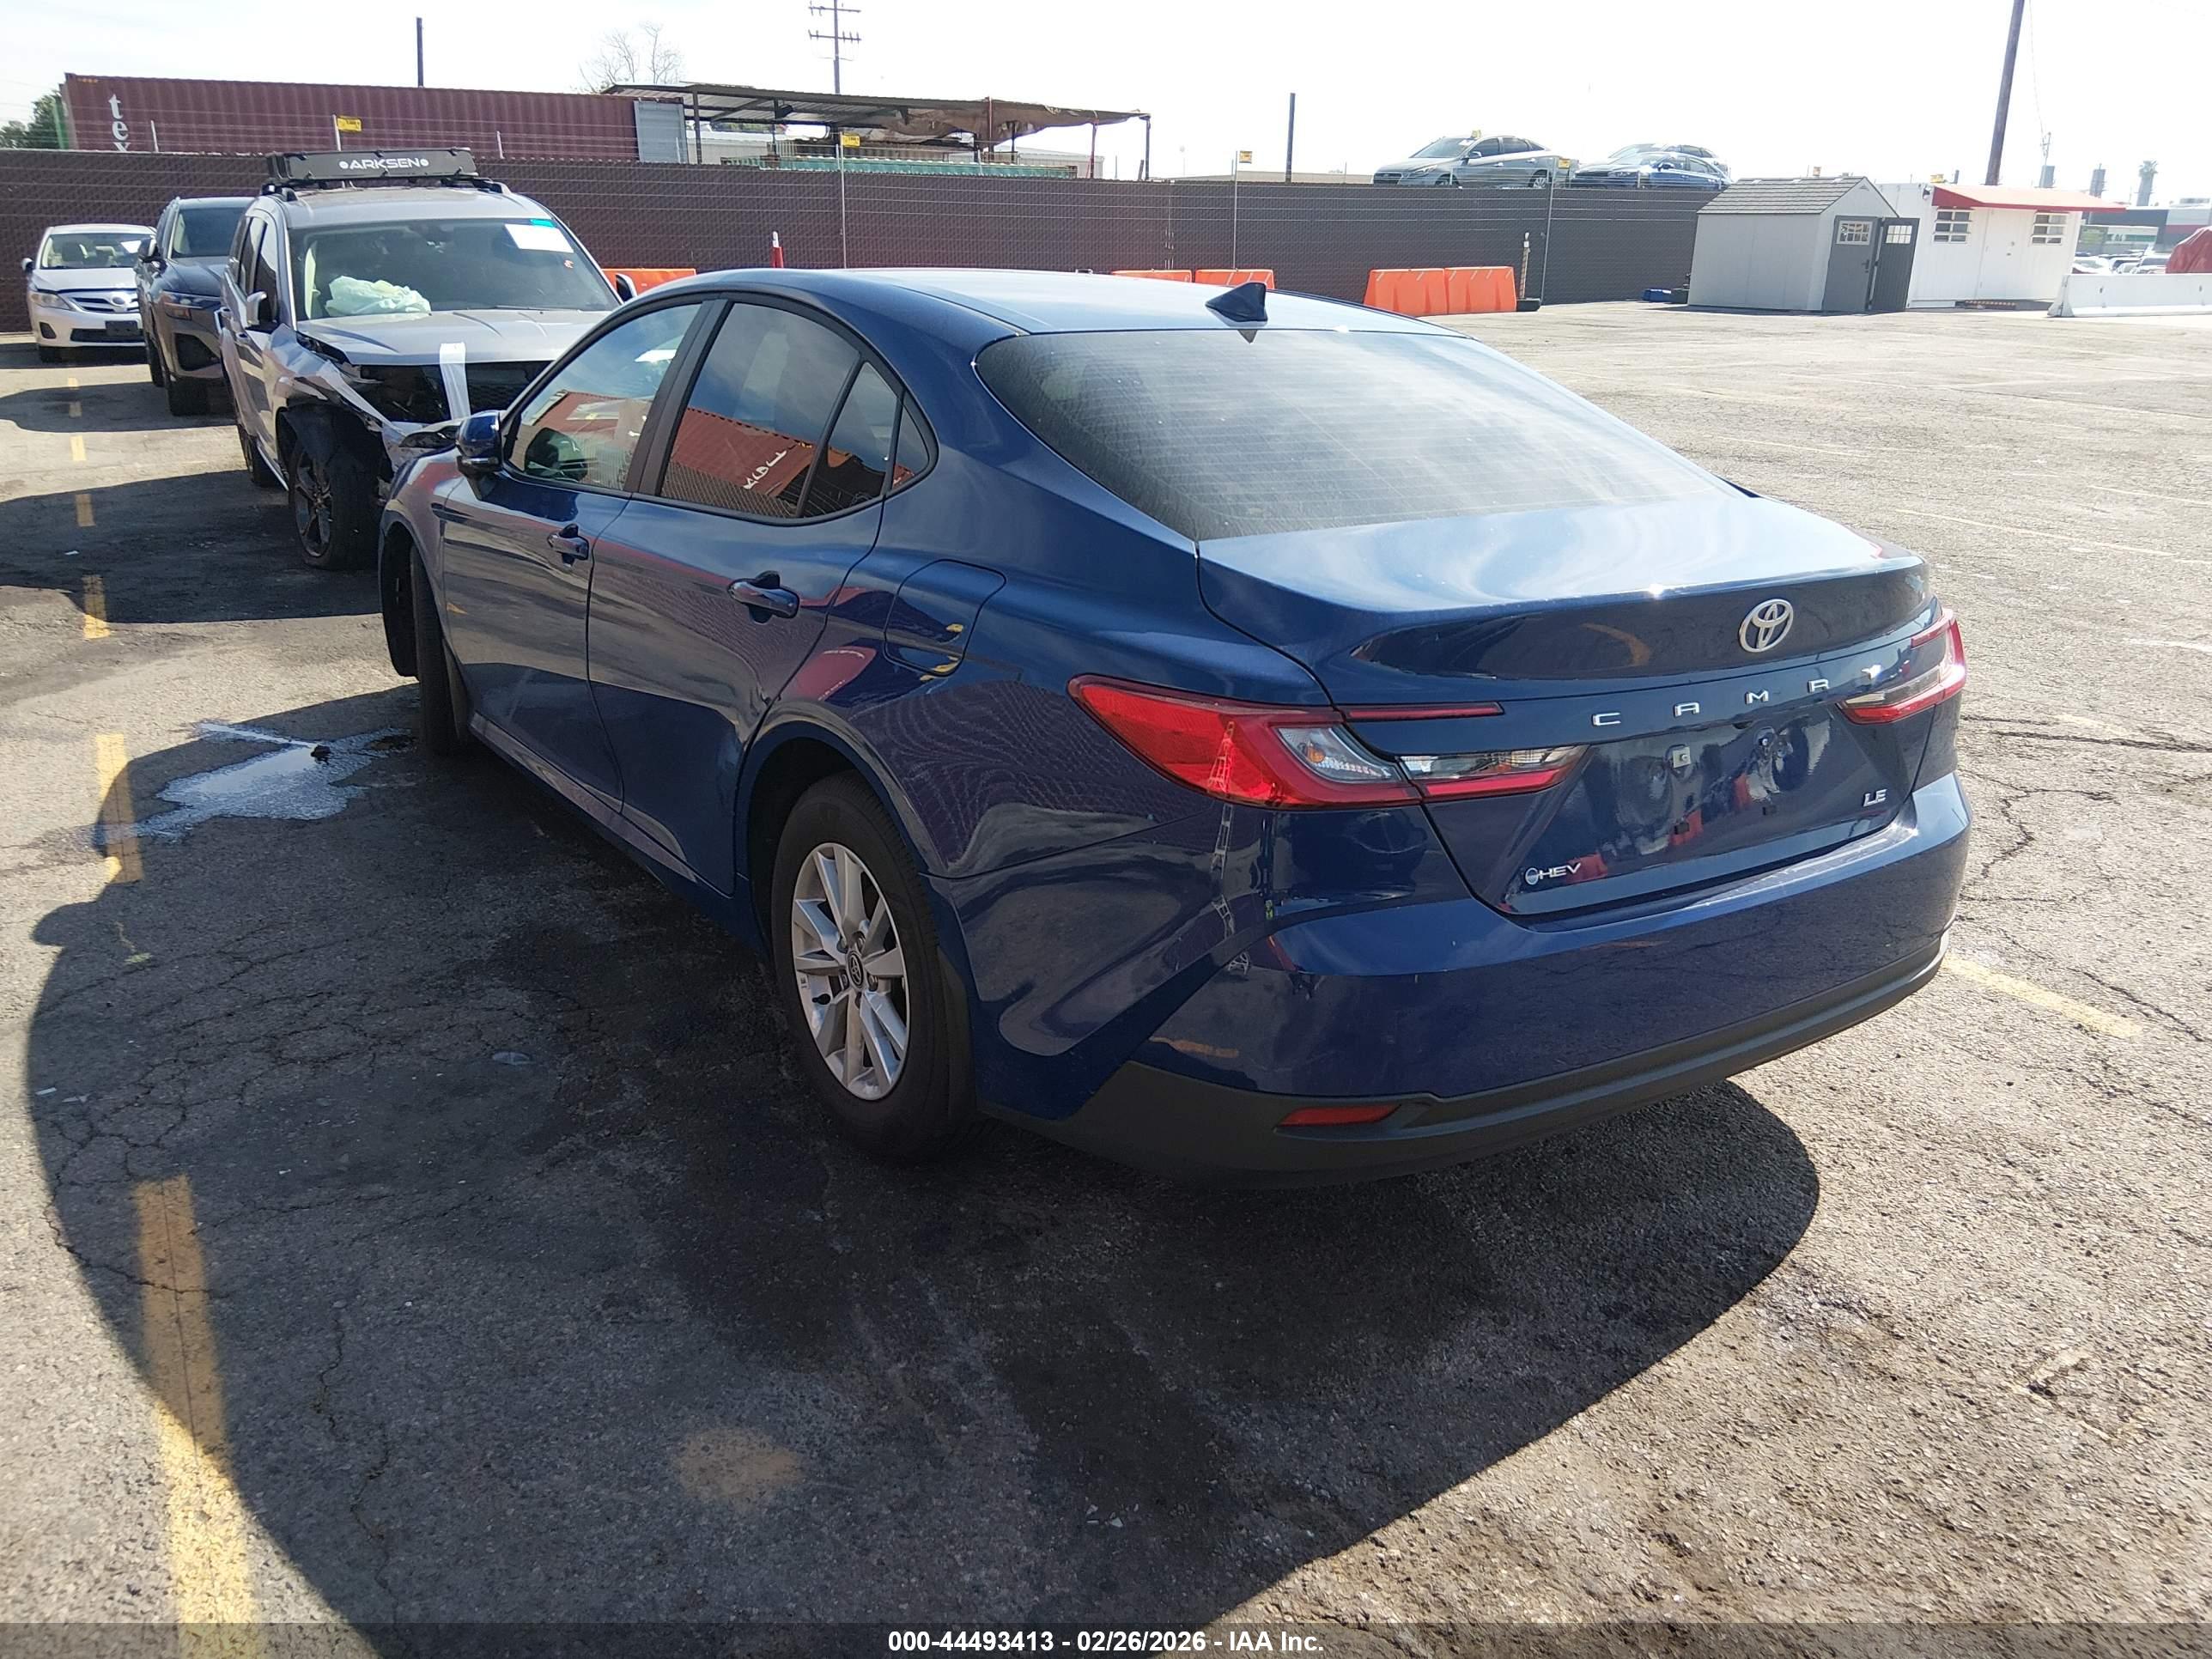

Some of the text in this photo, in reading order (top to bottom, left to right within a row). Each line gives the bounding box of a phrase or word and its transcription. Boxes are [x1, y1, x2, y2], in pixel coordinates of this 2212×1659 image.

[349, 157, 421, 170] ARKSEN
[1863, 788, 1887, 807] LE
[1538, 862, 1582, 880] HEV
